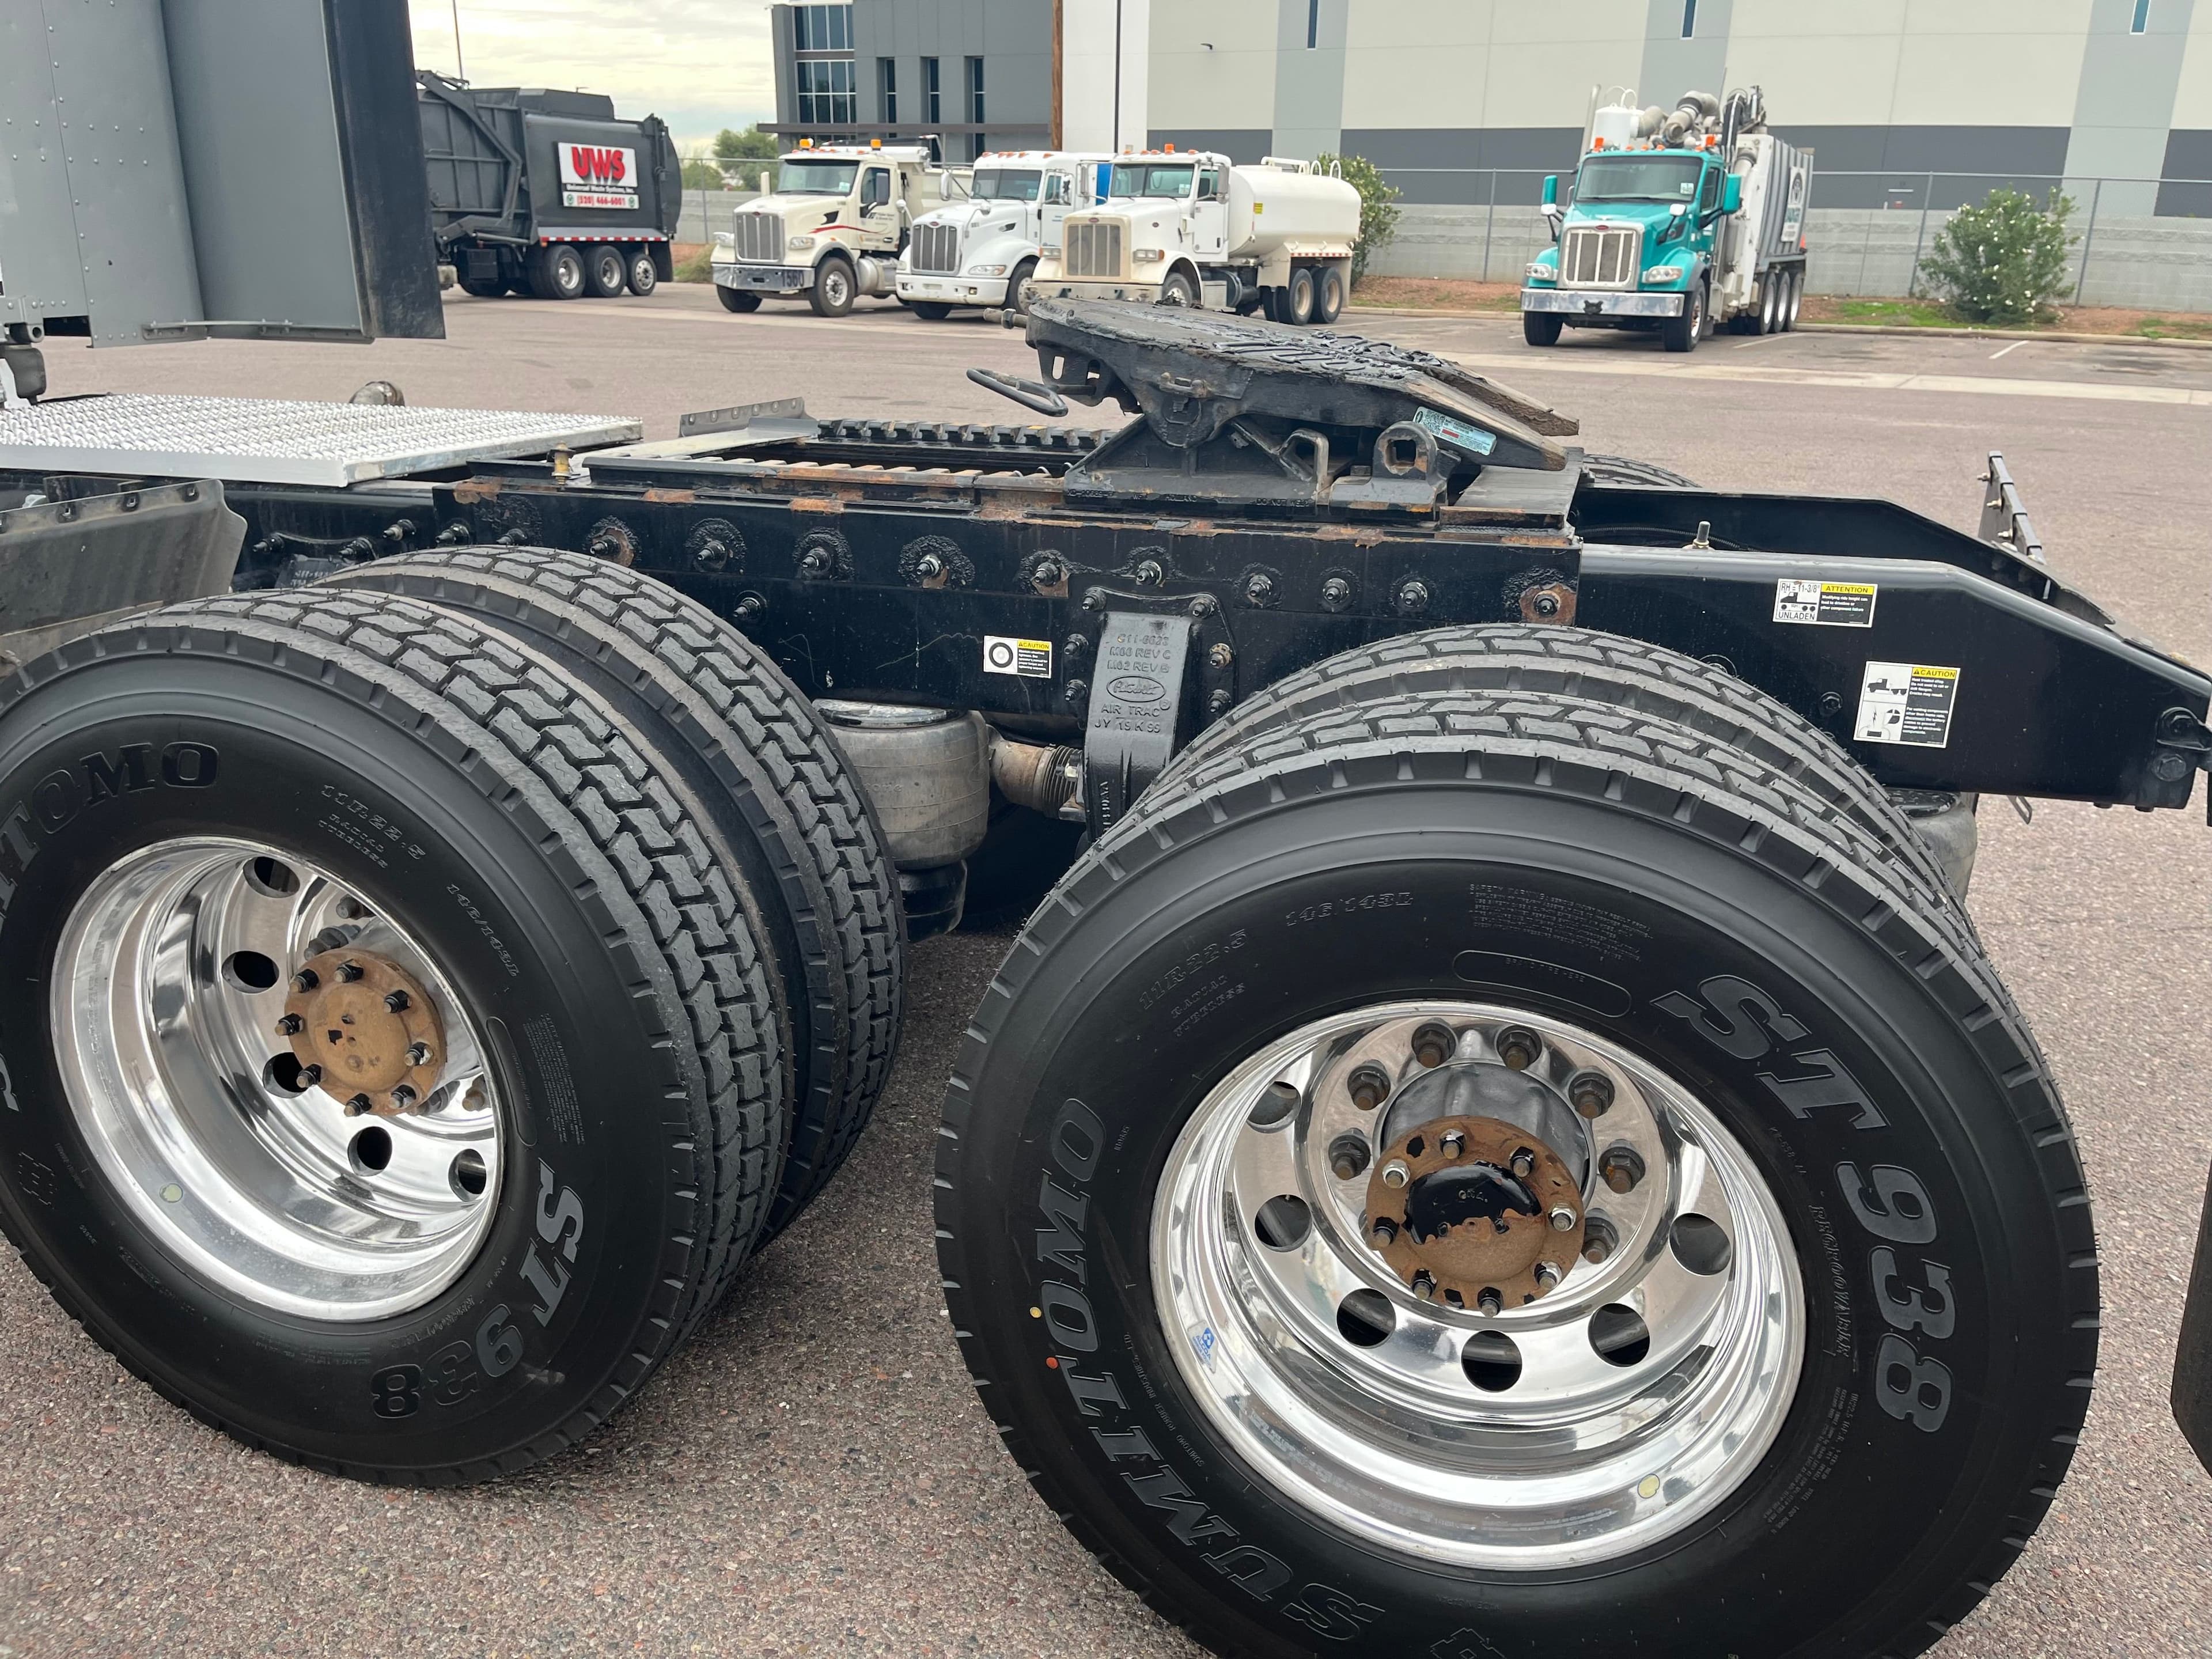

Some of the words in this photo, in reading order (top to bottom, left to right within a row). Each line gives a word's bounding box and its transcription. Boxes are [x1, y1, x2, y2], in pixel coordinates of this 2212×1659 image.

[571, 146, 626, 180] UWS
[1778, 611, 1815, 620] UNLADEN
[1023, 641, 1049, 650] CAUTION
[1921, 669, 1955, 678] CAUTION
[1101, 704, 1121, 714] AIR
[1128, 706, 1160, 717] TRAC
[1139, 928, 1247, 1010] 11R22.5
[1649, 974, 1891, 1129] ST
[1834, 1161, 1956, 1433] 938
[518, 1157, 584, 1327] ST
[370, 1304, 524, 1419] 938
[1035, 1098, 1385, 1642] SUMITOMO
